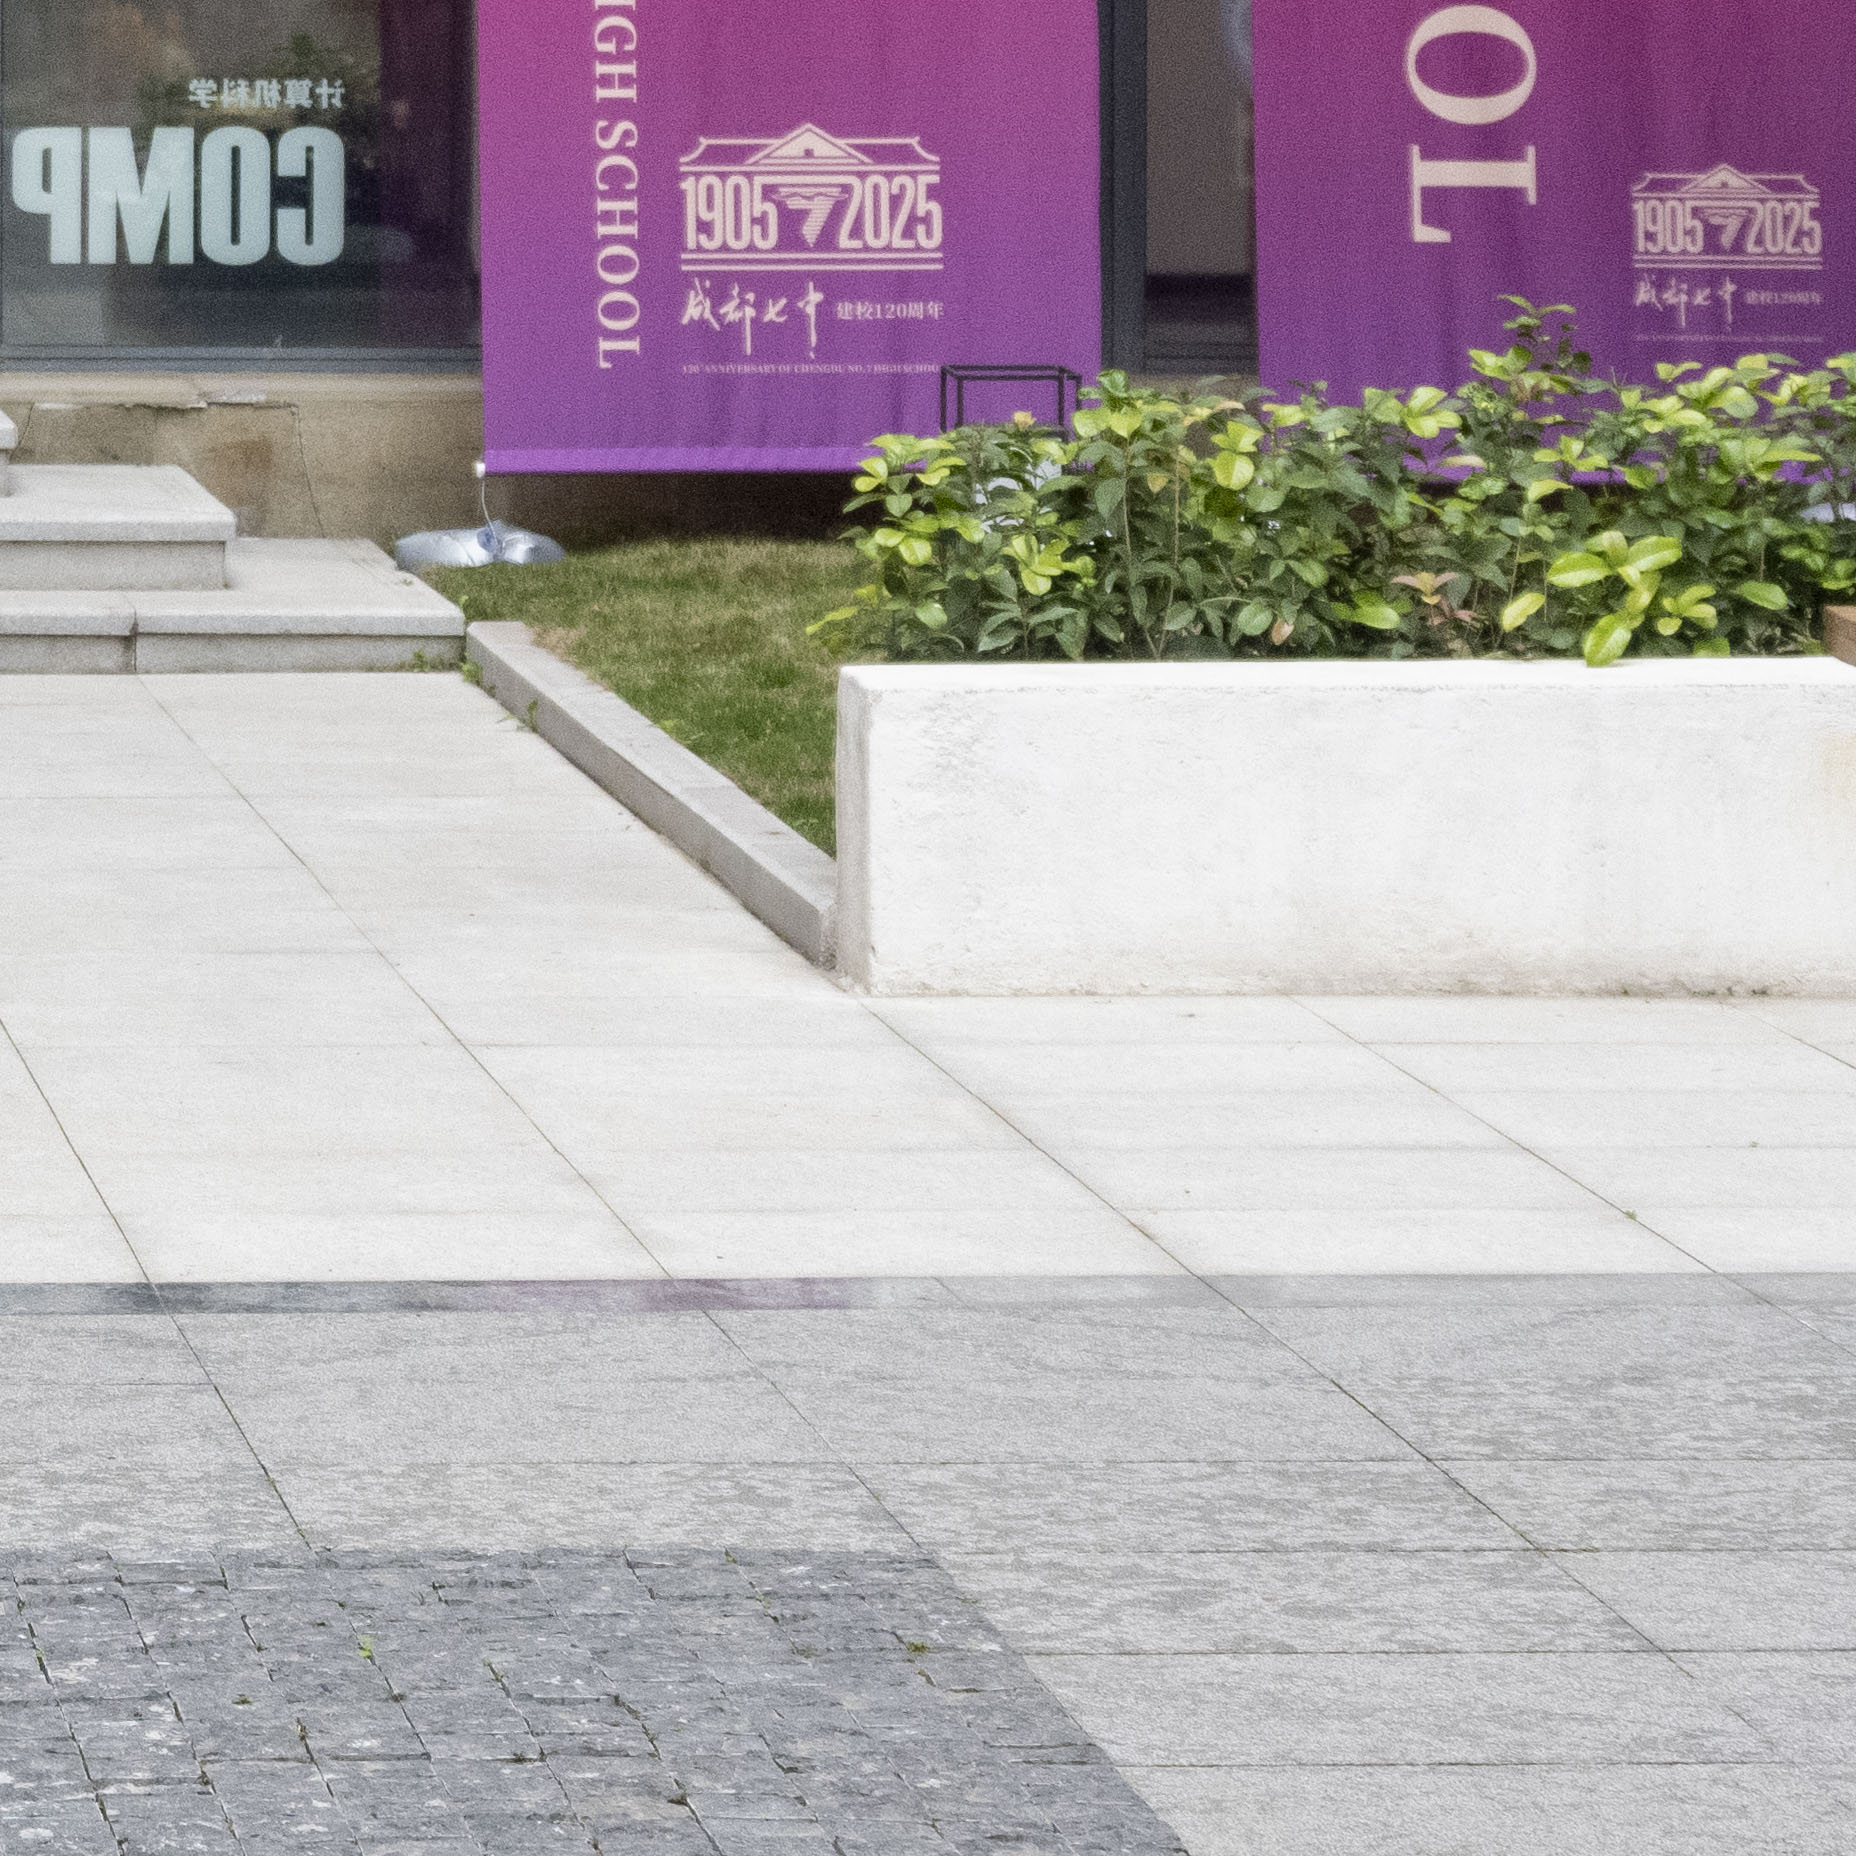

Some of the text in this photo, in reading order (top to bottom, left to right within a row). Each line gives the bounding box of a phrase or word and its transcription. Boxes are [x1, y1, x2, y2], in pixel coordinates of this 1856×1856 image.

[594, 119, 642, 371] SCHOOL
[680, 175, 779, 250] 1905
[838, 175, 943, 250] 2025
[1633, 199, 1704, 254] 1905
[1745, 200, 1823, 255] 2025
[837, 301, 944, 320] 建校120周年
